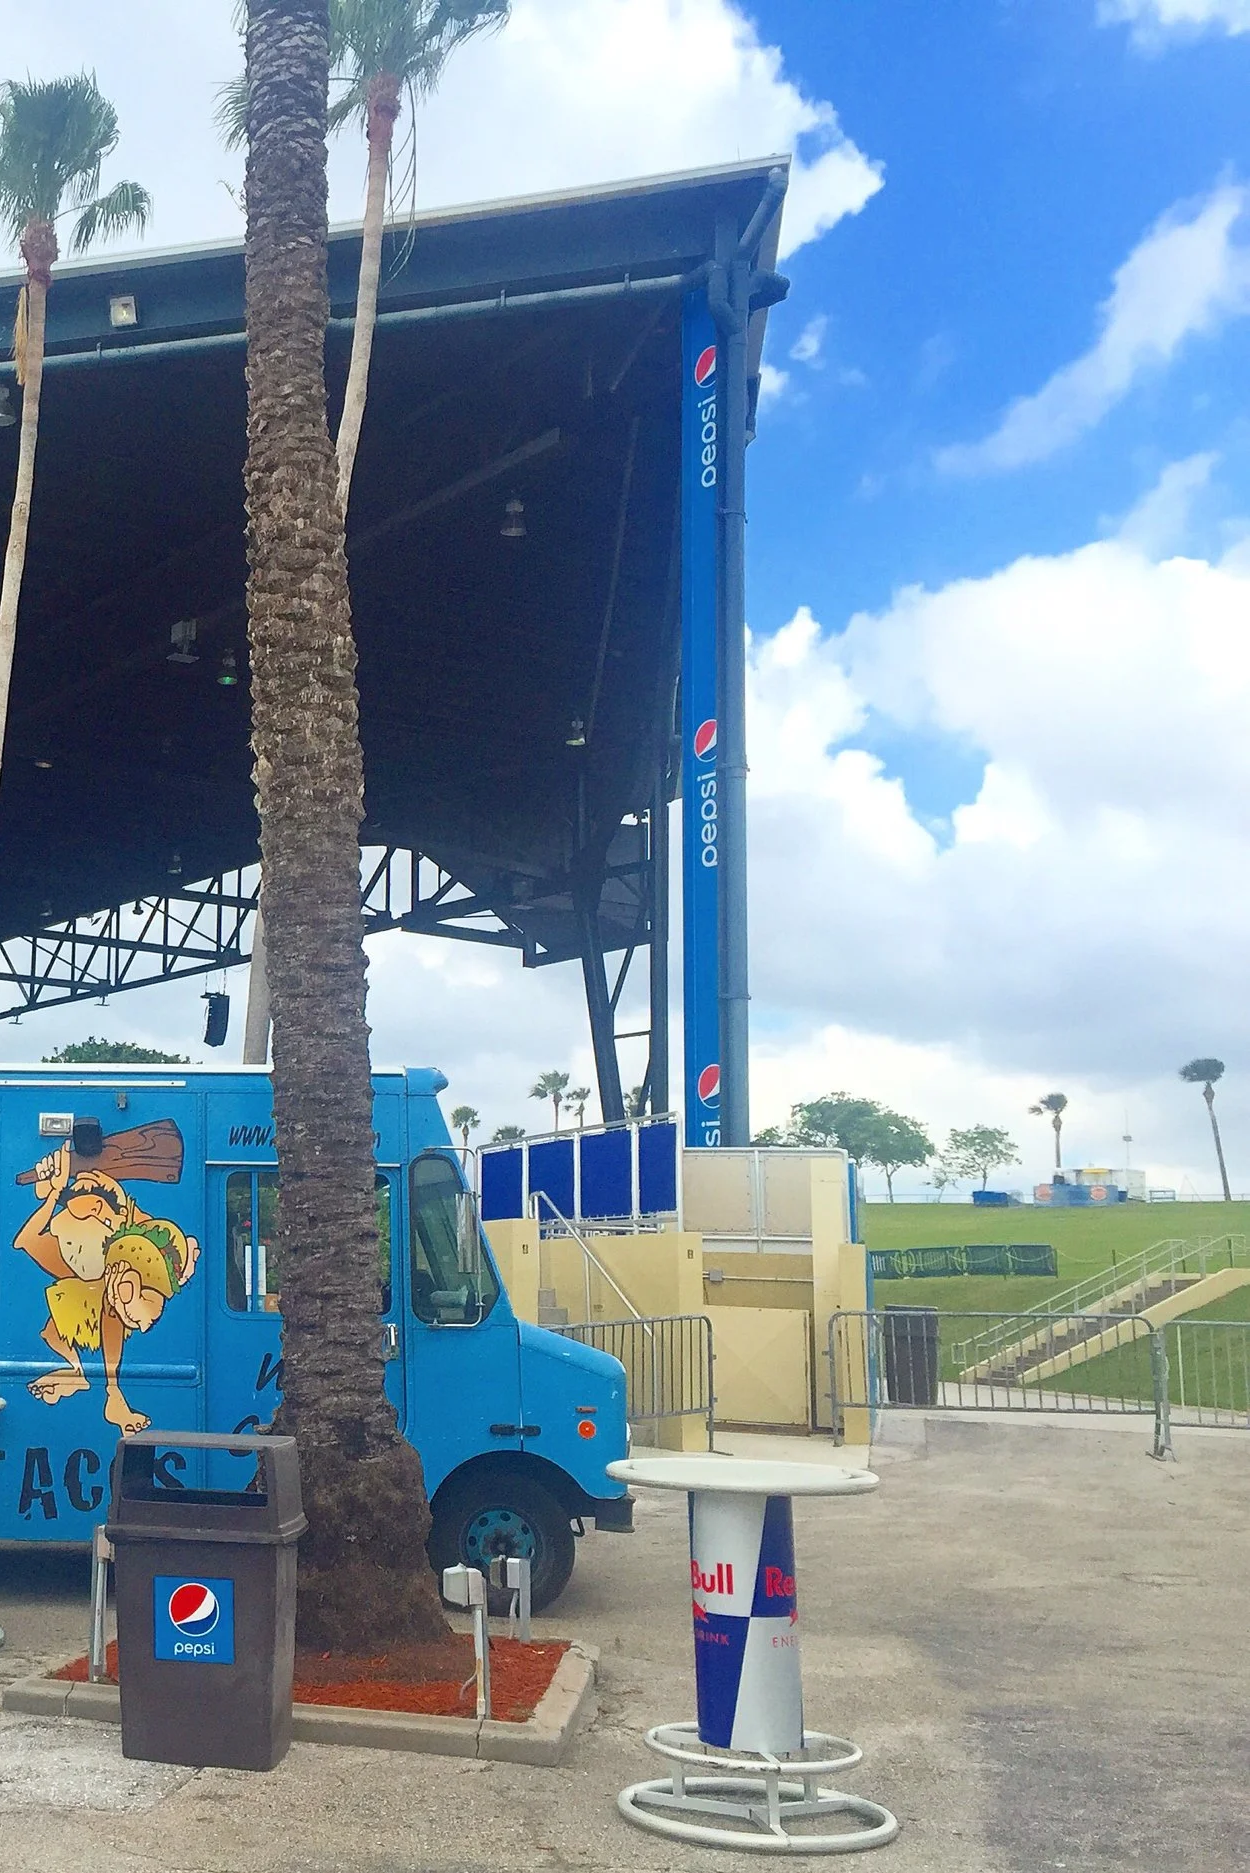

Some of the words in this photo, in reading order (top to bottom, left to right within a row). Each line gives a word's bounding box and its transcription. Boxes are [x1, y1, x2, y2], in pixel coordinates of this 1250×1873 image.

[696, 770, 718, 868] pepsi
[691, 1559, 734, 1595] Bull
[765, 1565, 796, 1598] Re
[174, 1642, 215, 1657] pepsi
